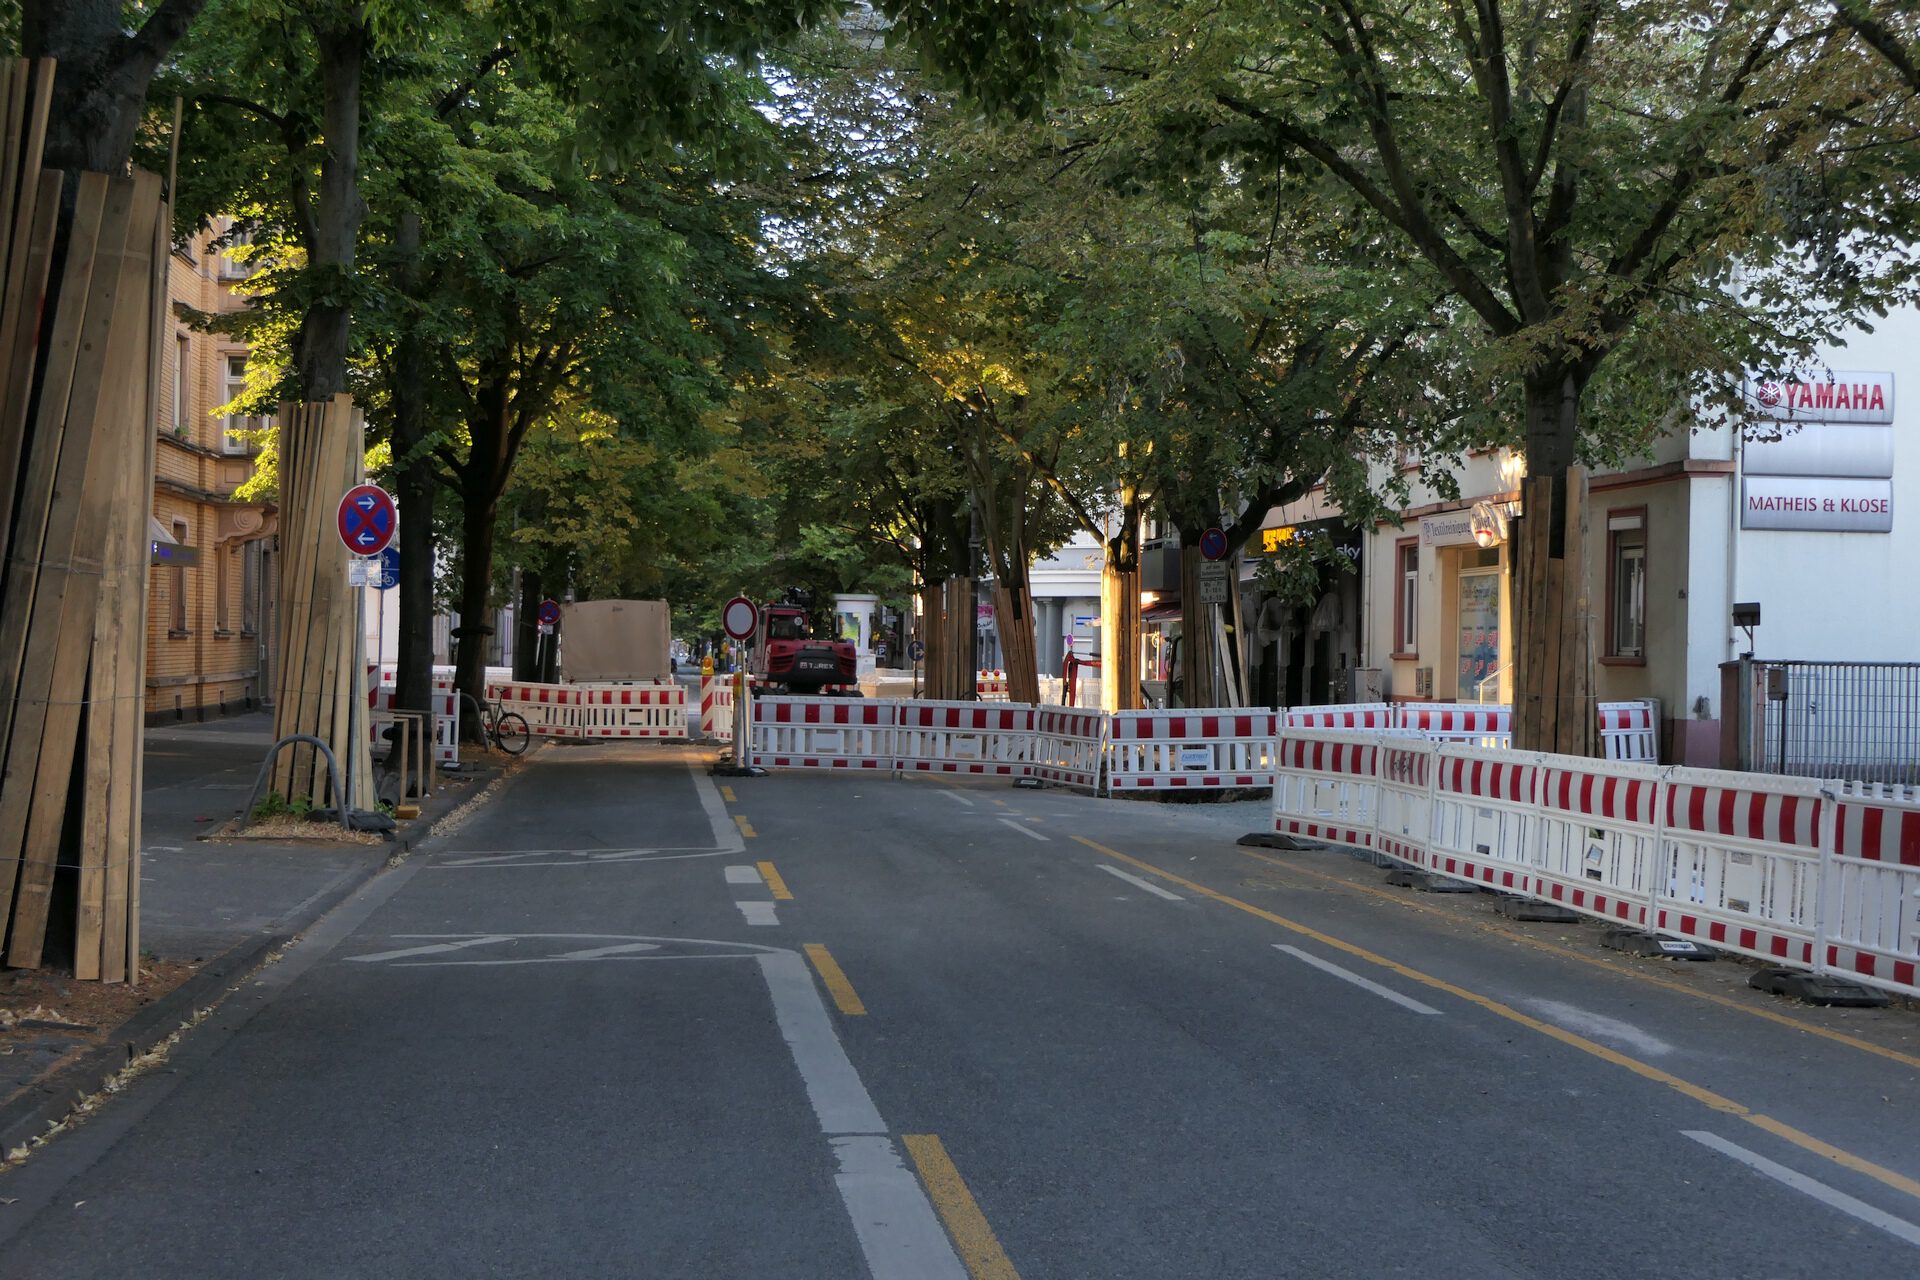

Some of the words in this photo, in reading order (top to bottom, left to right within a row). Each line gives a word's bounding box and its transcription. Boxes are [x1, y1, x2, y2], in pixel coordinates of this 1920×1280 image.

[1785, 383, 1885, 410] YAMAHA
[1749, 496, 1817, 512] MATHEIS
[1823, 498, 1835, 513] &
[1841, 498, 1889, 514] KLOSE
[1335, 543, 1361, 560] sky
